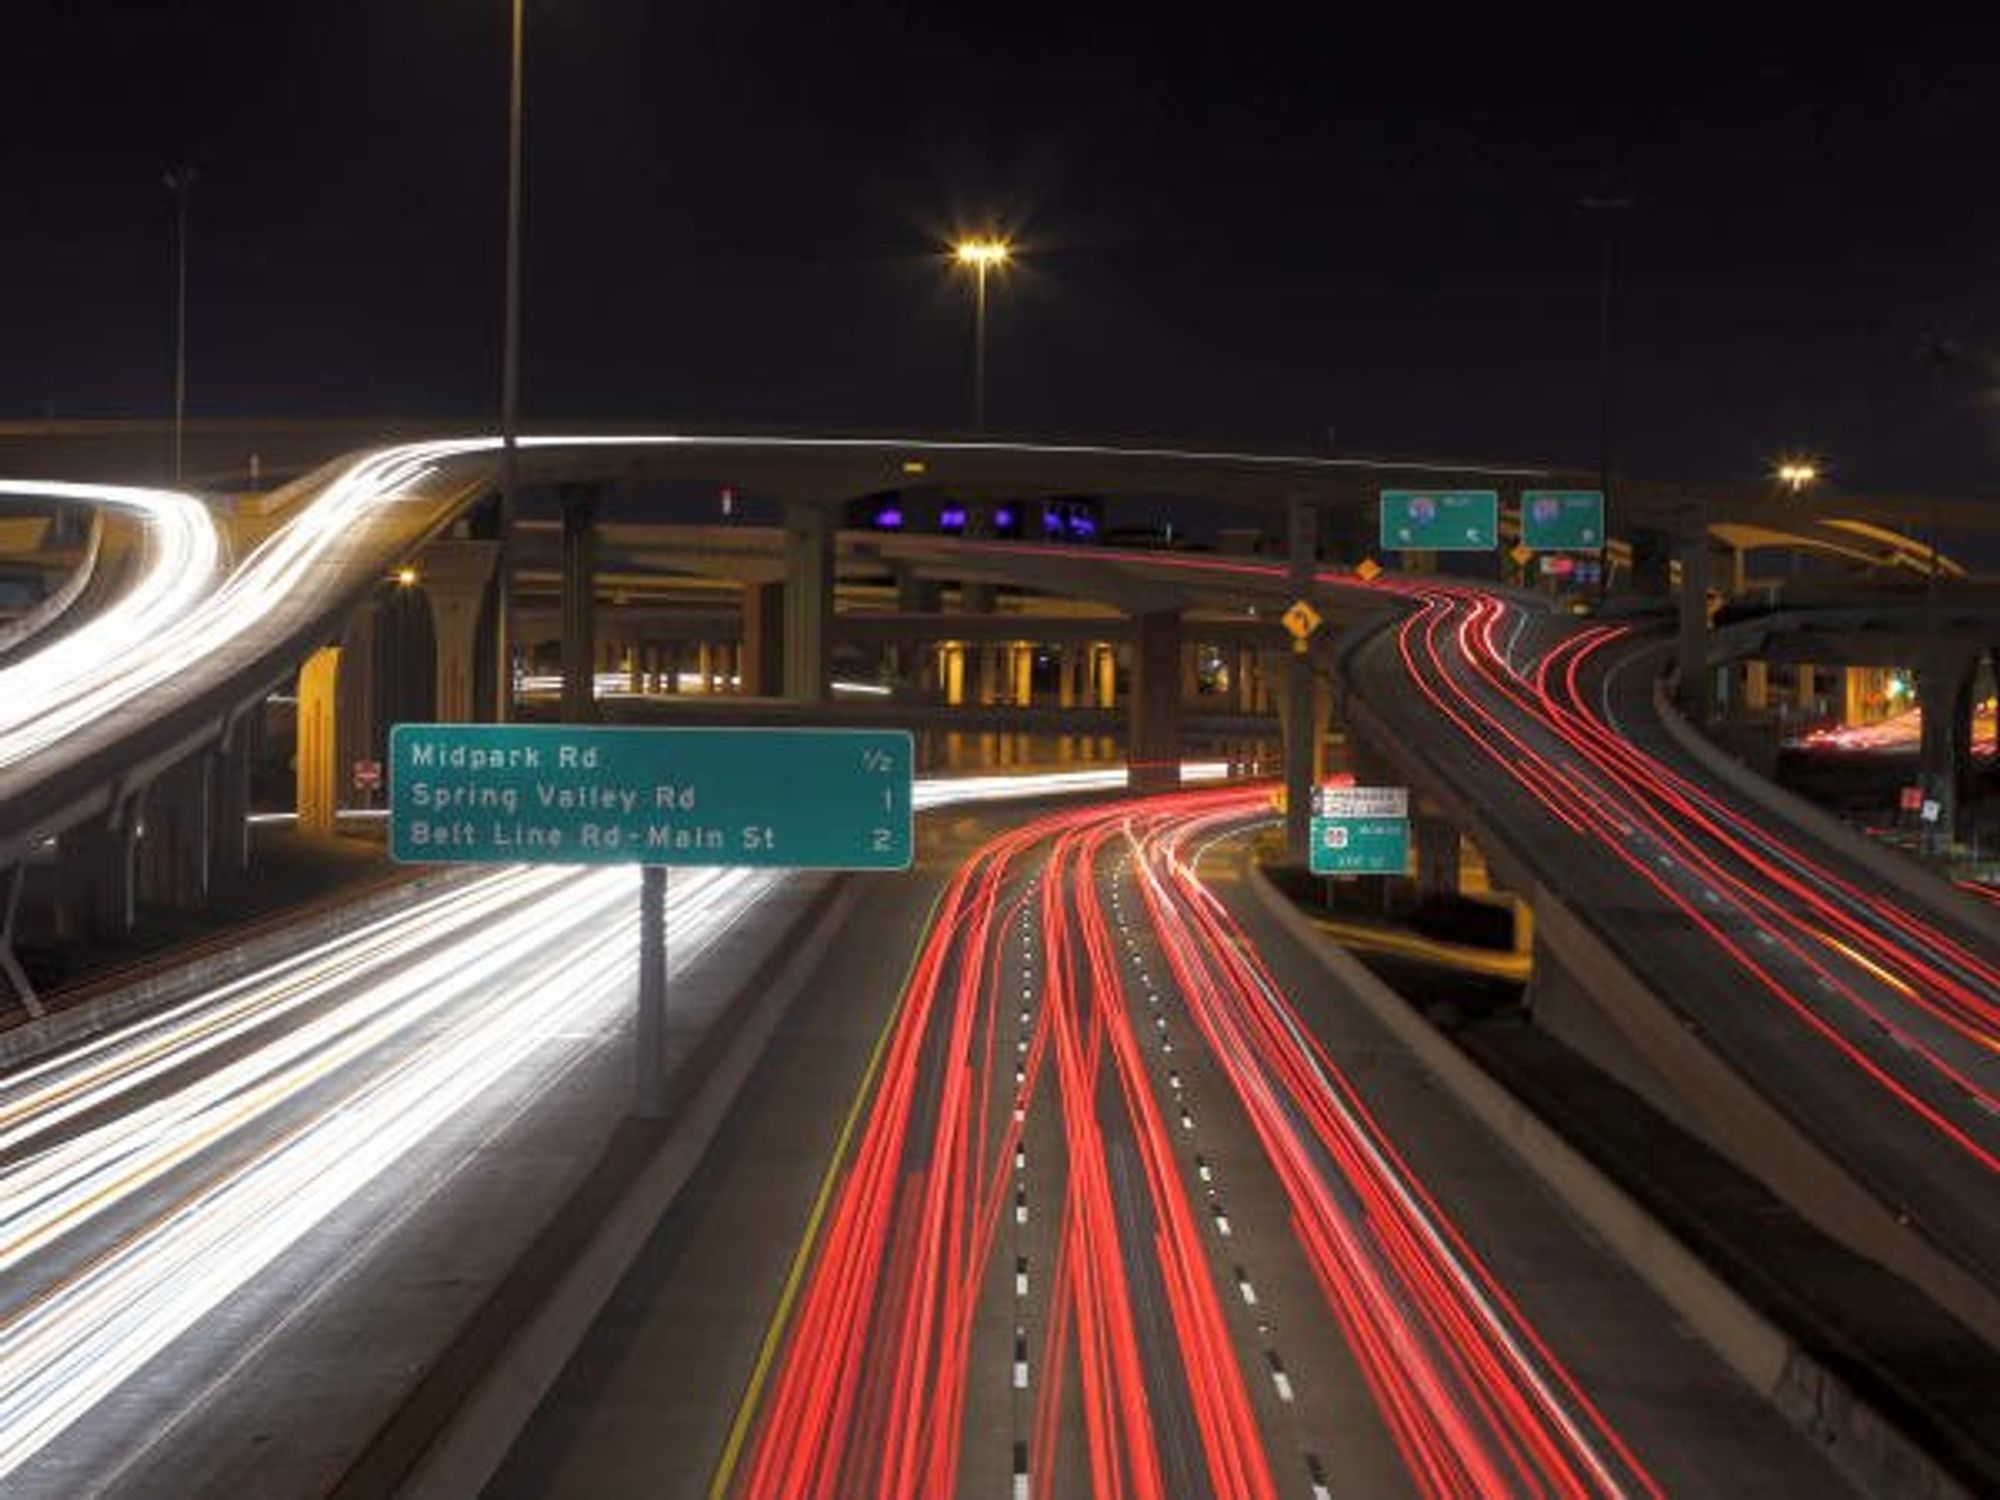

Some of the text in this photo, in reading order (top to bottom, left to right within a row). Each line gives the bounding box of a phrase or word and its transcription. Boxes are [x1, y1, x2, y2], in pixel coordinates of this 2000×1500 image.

[411, 743, 599, 770] Midpark Rd
[411, 781, 695, 815] Spring Valley Rd
[410, 821, 475, 845] Belt
[493, 823, 562, 846] Line
[743, 827, 775, 849] St
[873, 828, 892, 852] 2
